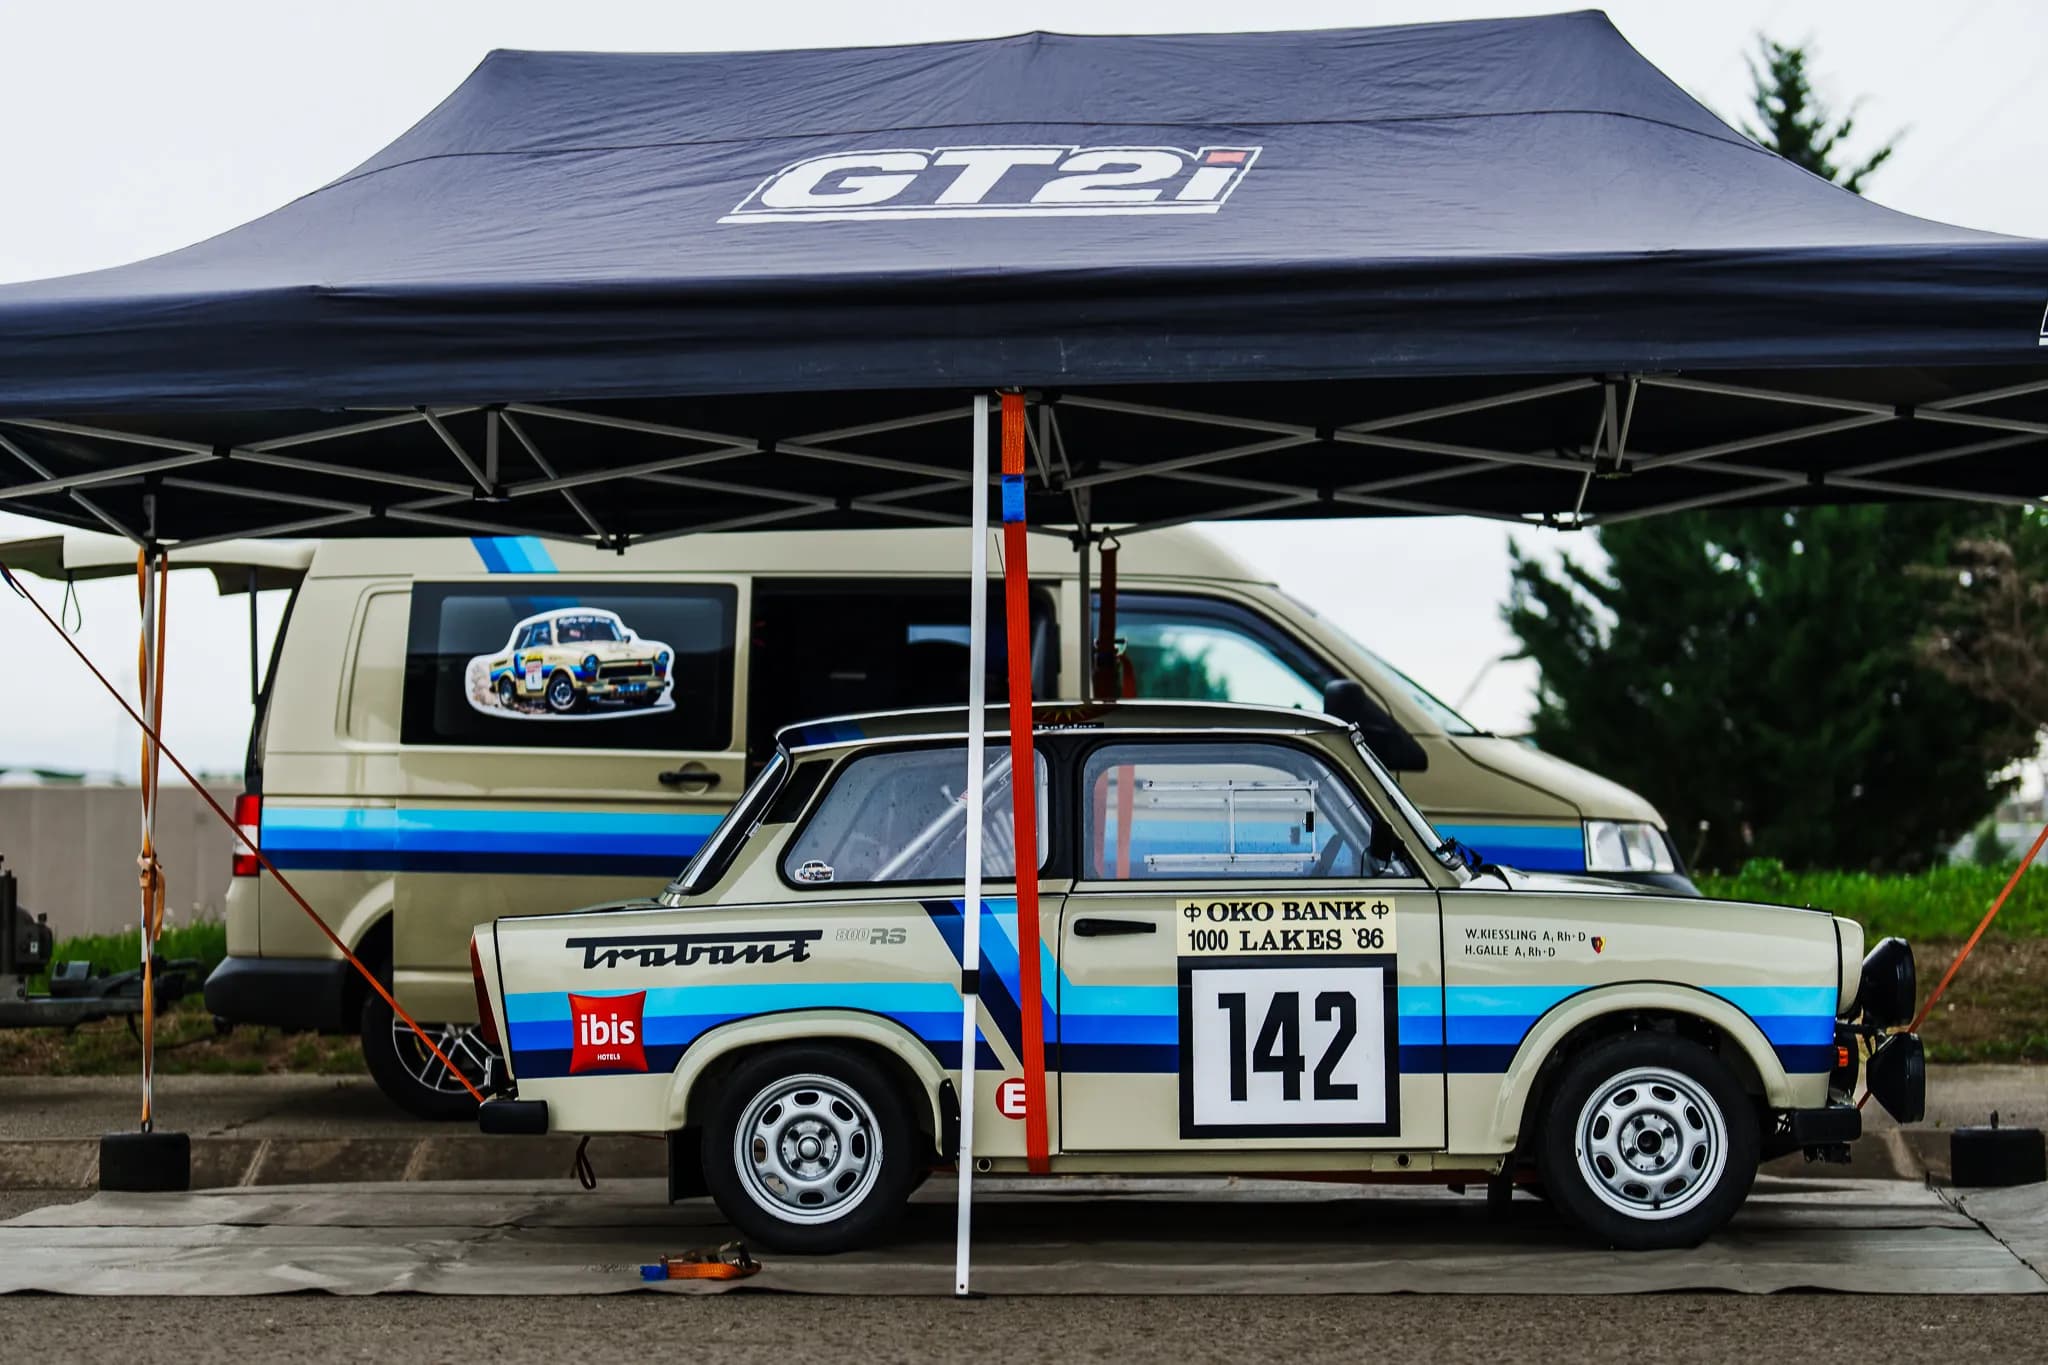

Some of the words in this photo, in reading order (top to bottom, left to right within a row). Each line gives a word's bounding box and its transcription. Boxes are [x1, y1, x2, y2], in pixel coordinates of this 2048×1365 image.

[761, 148, 1247, 208] GT2i
[1206, 901, 1275, 923] OKO
[1281, 901, 1367, 921] BANK
[565, 929, 824, 969] Trabant
[1187, 929, 1229, 951] 1000
[1239, 928, 1342, 951] LAKES
[580, 1012, 635, 1046] ibis
[597, 1052, 621, 1061] HOTELS
[1217, 990, 1359, 1103] 142
[1003, 1082, 1027, 1114] E
